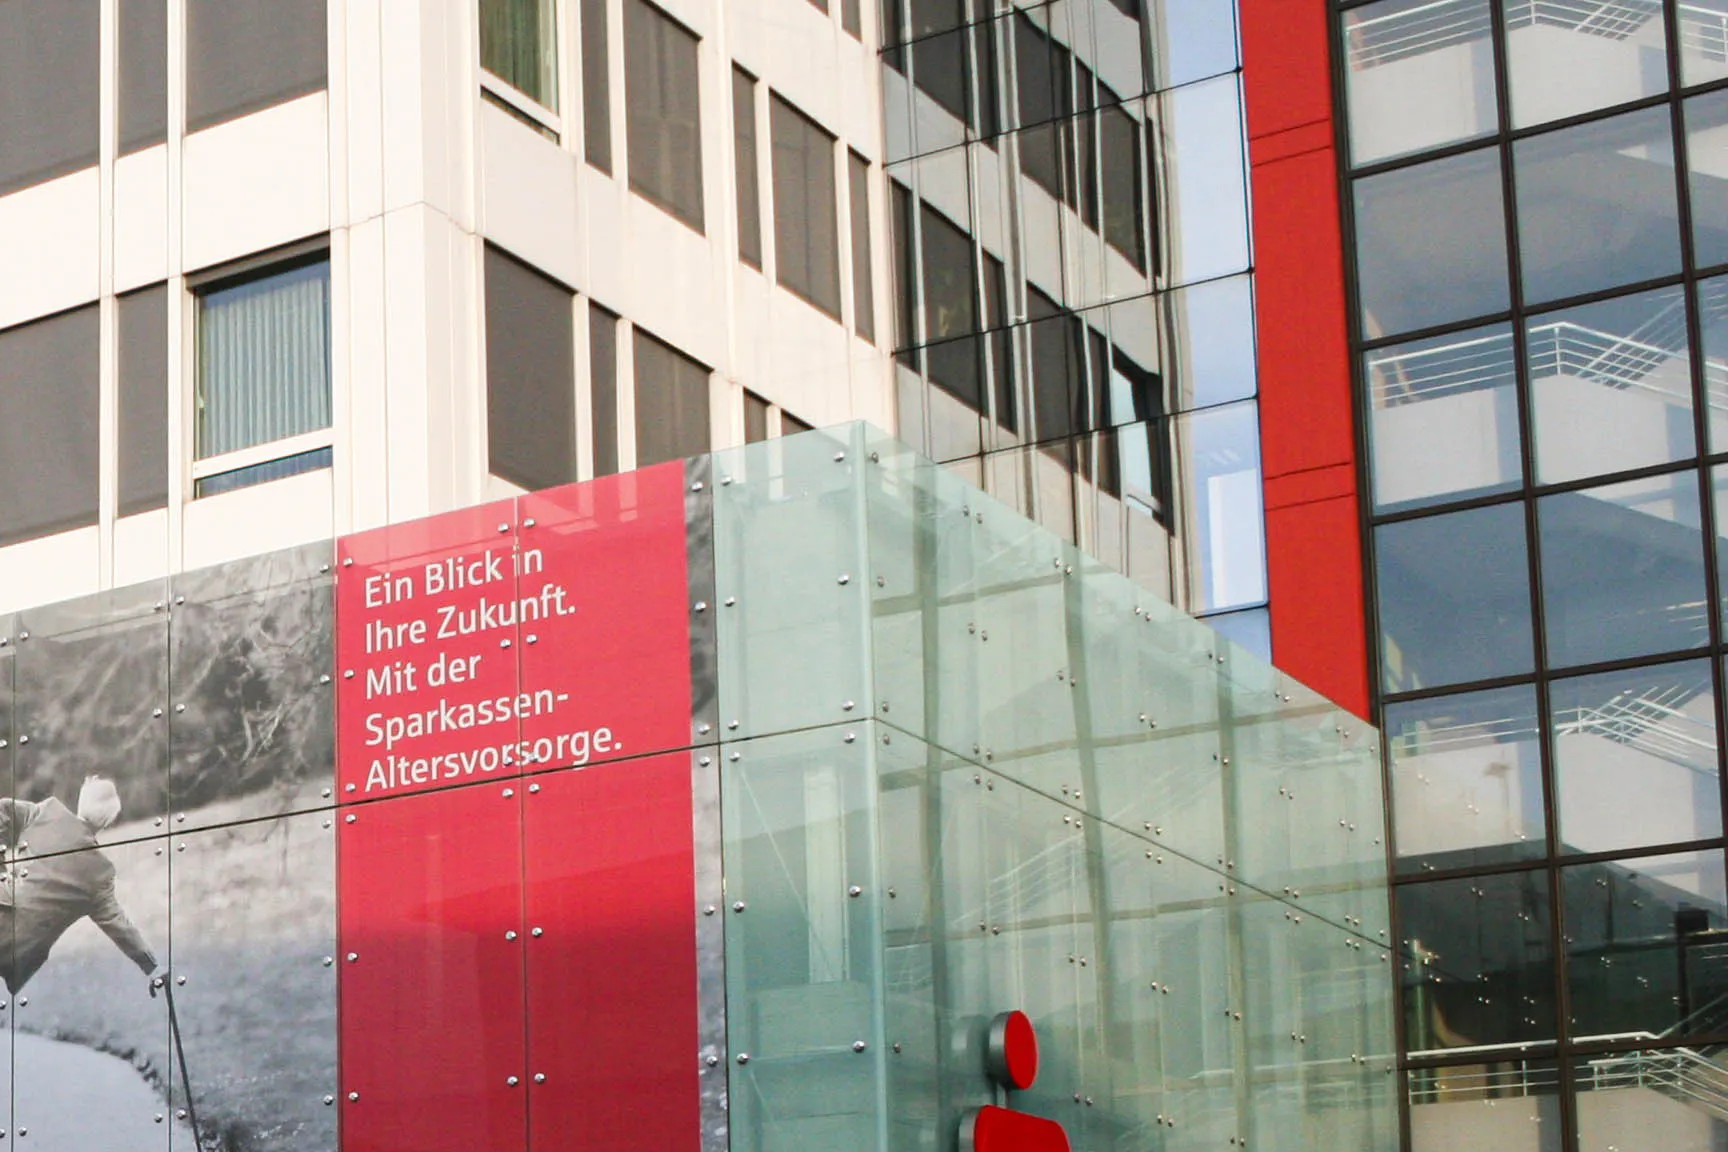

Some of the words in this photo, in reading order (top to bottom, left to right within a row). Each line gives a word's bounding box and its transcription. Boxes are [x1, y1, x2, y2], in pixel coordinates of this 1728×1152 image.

[365, 573, 413, 609] Ein
[425, 549, 503, 596] Blick
[512, 546, 543, 577] in
[365, 618, 426, 654] Ihre
[437, 583, 576, 640] Zukunft.
[365, 663, 417, 700] Mit
[427, 651, 482, 685] der
[365, 687, 569, 750] Sparkassen-
[364, 725, 623, 792] Altersvorsorge.
